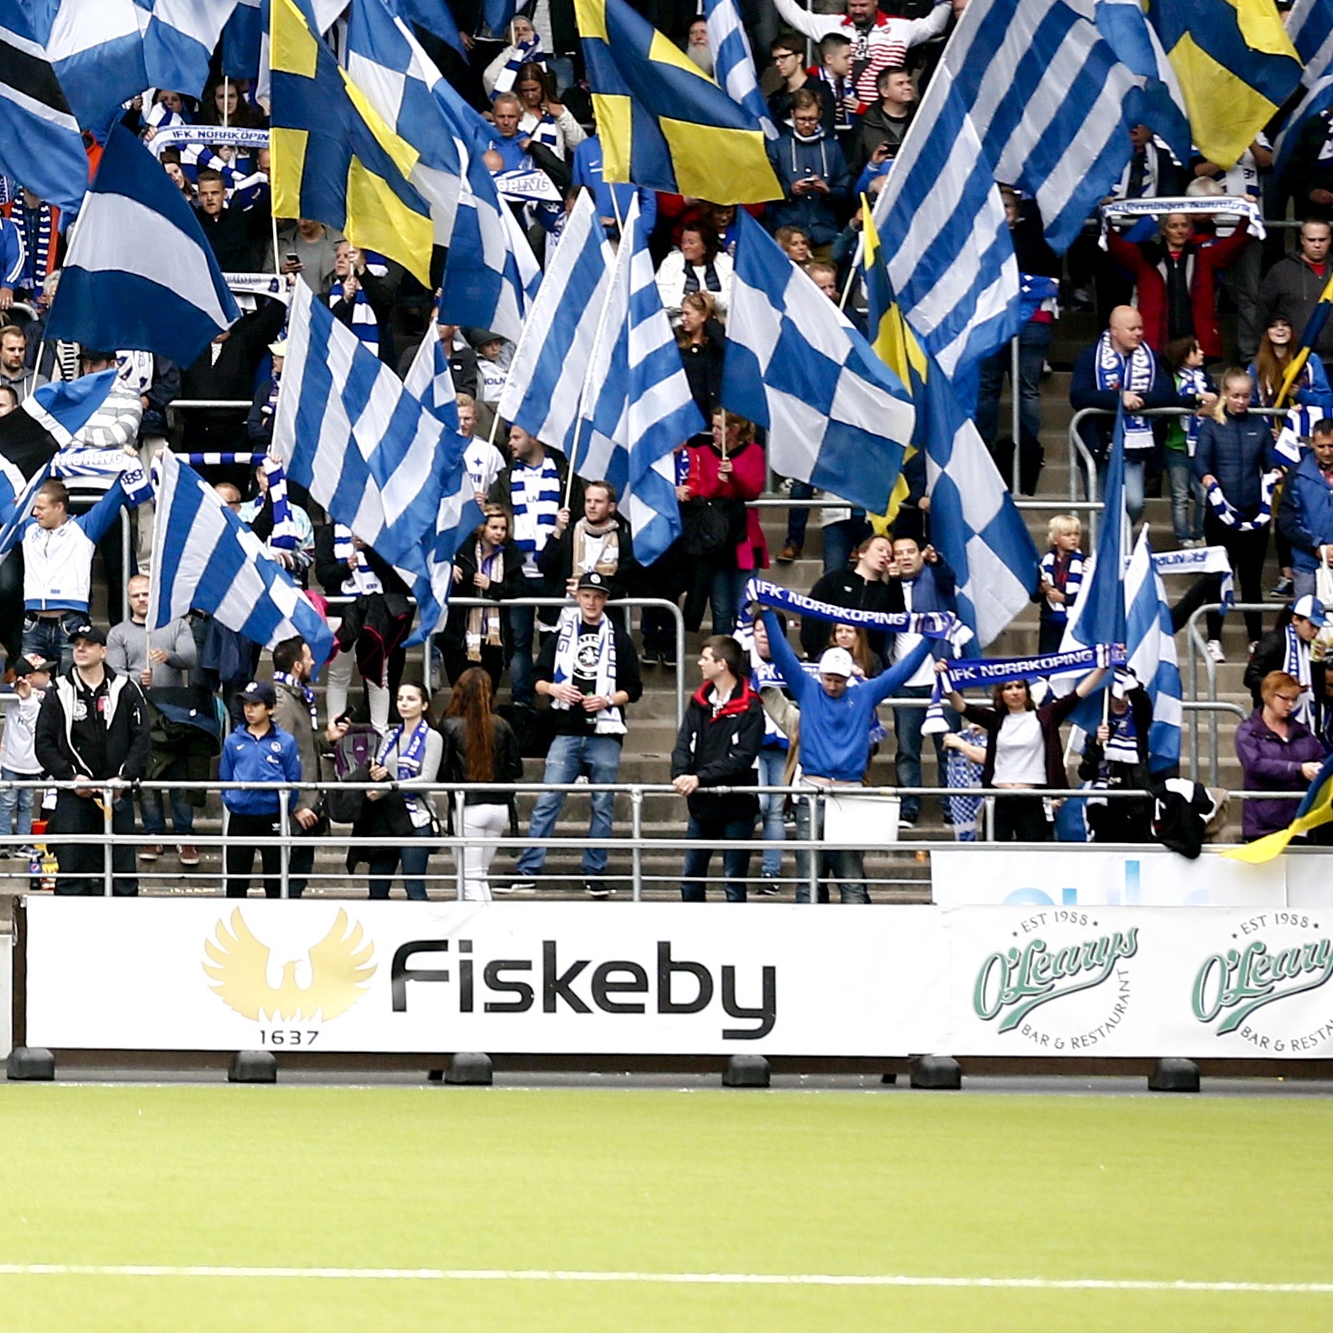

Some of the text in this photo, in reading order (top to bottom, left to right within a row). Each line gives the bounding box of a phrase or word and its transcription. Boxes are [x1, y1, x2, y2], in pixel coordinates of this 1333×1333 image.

[171, 129, 270, 143] IFK NORRKÖPIN
[755, 580, 908, 627] IFK NORRKÖPING
[948, 647, 1094, 683] IFK NORRKÖPING
[1020, 910, 1089, 933] EST 1988
[1240, 912, 1310, 935] EST 1988
[391, 939, 777, 1041] Fiskeby
[972, 928, 1140, 1021] O'Learys
[1020, 967, 1132, 1050] BAR & RESTAURANT
[259, 1029, 320, 1046] 1637
[1240, 1025, 1270, 1051] BAR
[1274, 1038, 1286, 1052] &
